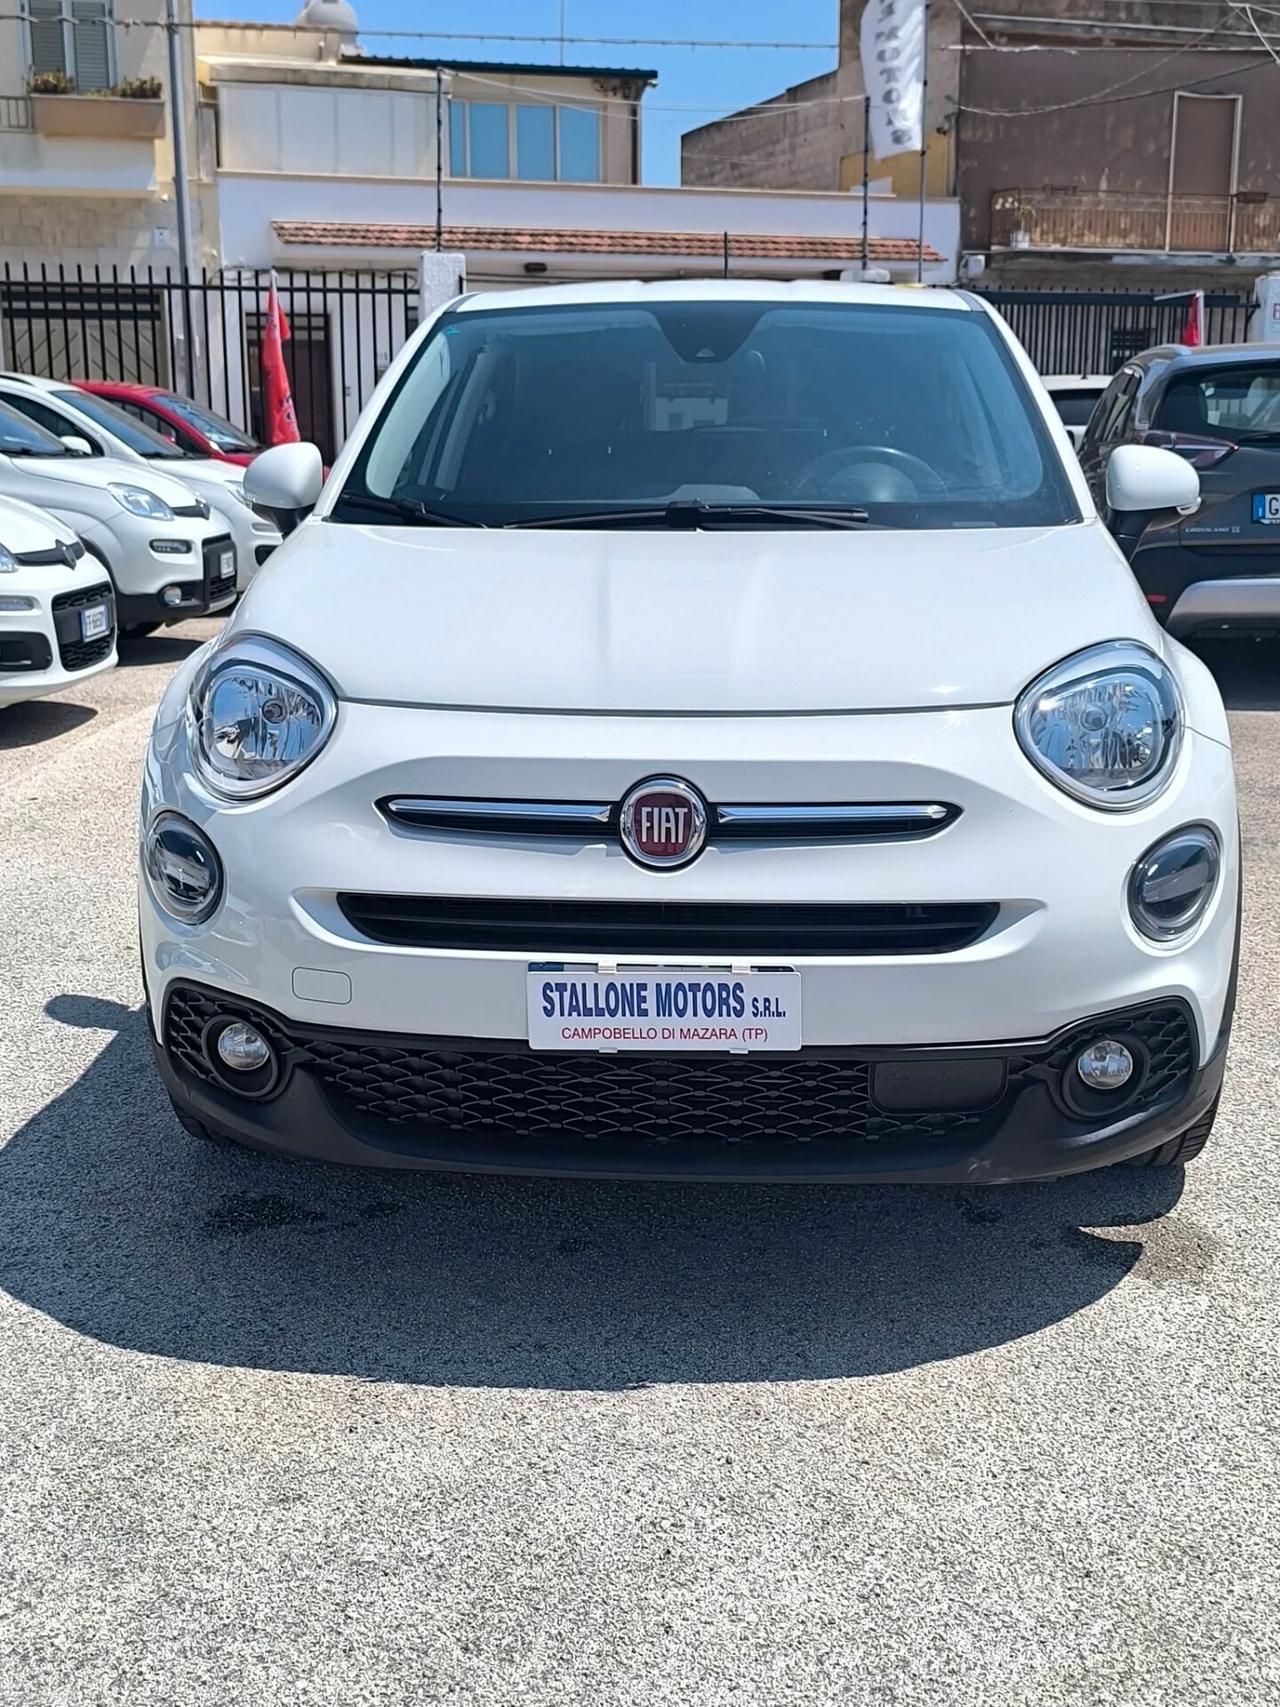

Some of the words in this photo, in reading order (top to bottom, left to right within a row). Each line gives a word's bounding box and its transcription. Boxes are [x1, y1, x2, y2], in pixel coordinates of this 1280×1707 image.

[641, 807, 688, 843] FIAT
[542, 982, 648, 1018] STALLONE
[655, 982, 745, 1018] MOTORS
[752, 997, 786, 1018] S.R.L.
[561, 1027, 658, 1040] CAMPOBELLO
[661, 1028, 676, 1040] DI
[679, 1028, 738, 1040] MAZARA
[742, 1028, 768, 1042] (TP)
